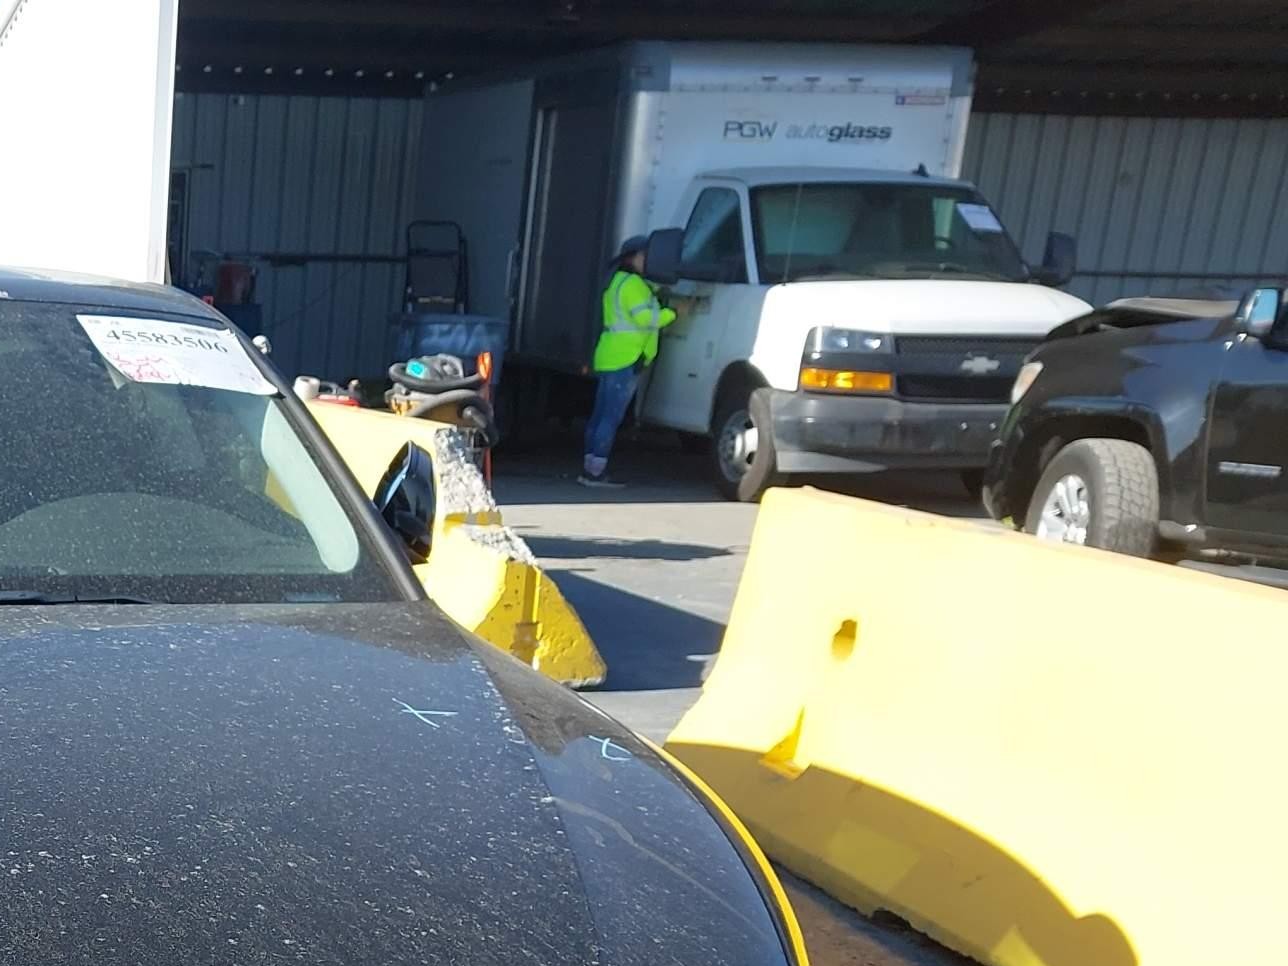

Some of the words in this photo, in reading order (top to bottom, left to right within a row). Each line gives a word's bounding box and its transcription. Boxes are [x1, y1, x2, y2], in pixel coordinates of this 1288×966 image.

[723, 120, 778, 139] PGW
[785, 121, 892, 142] autoglass
[106, 329, 228, 354] 45583506
